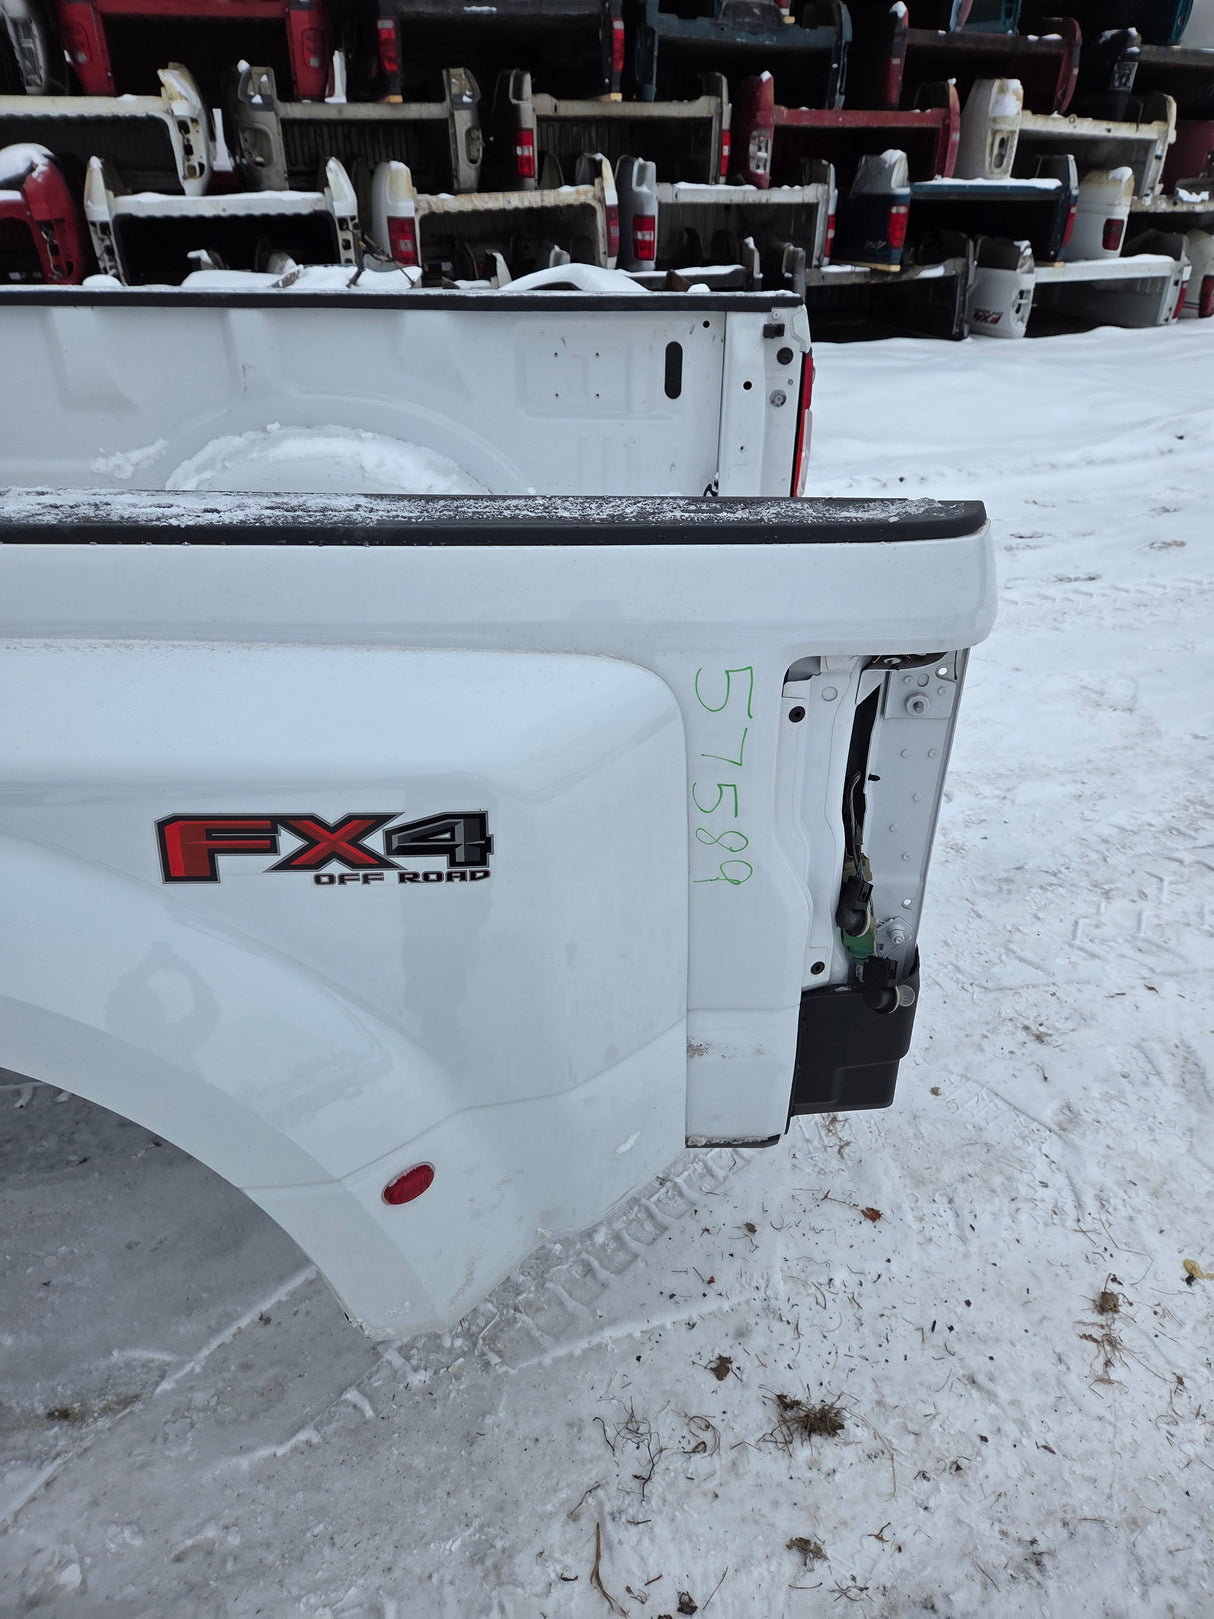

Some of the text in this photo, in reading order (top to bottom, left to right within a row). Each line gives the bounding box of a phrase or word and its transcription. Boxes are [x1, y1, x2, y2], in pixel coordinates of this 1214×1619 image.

[692, 666, 753, 885] 57589
[154, 810, 495, 884] FX4
[313, 869, 492, 886] OFF ROAD
